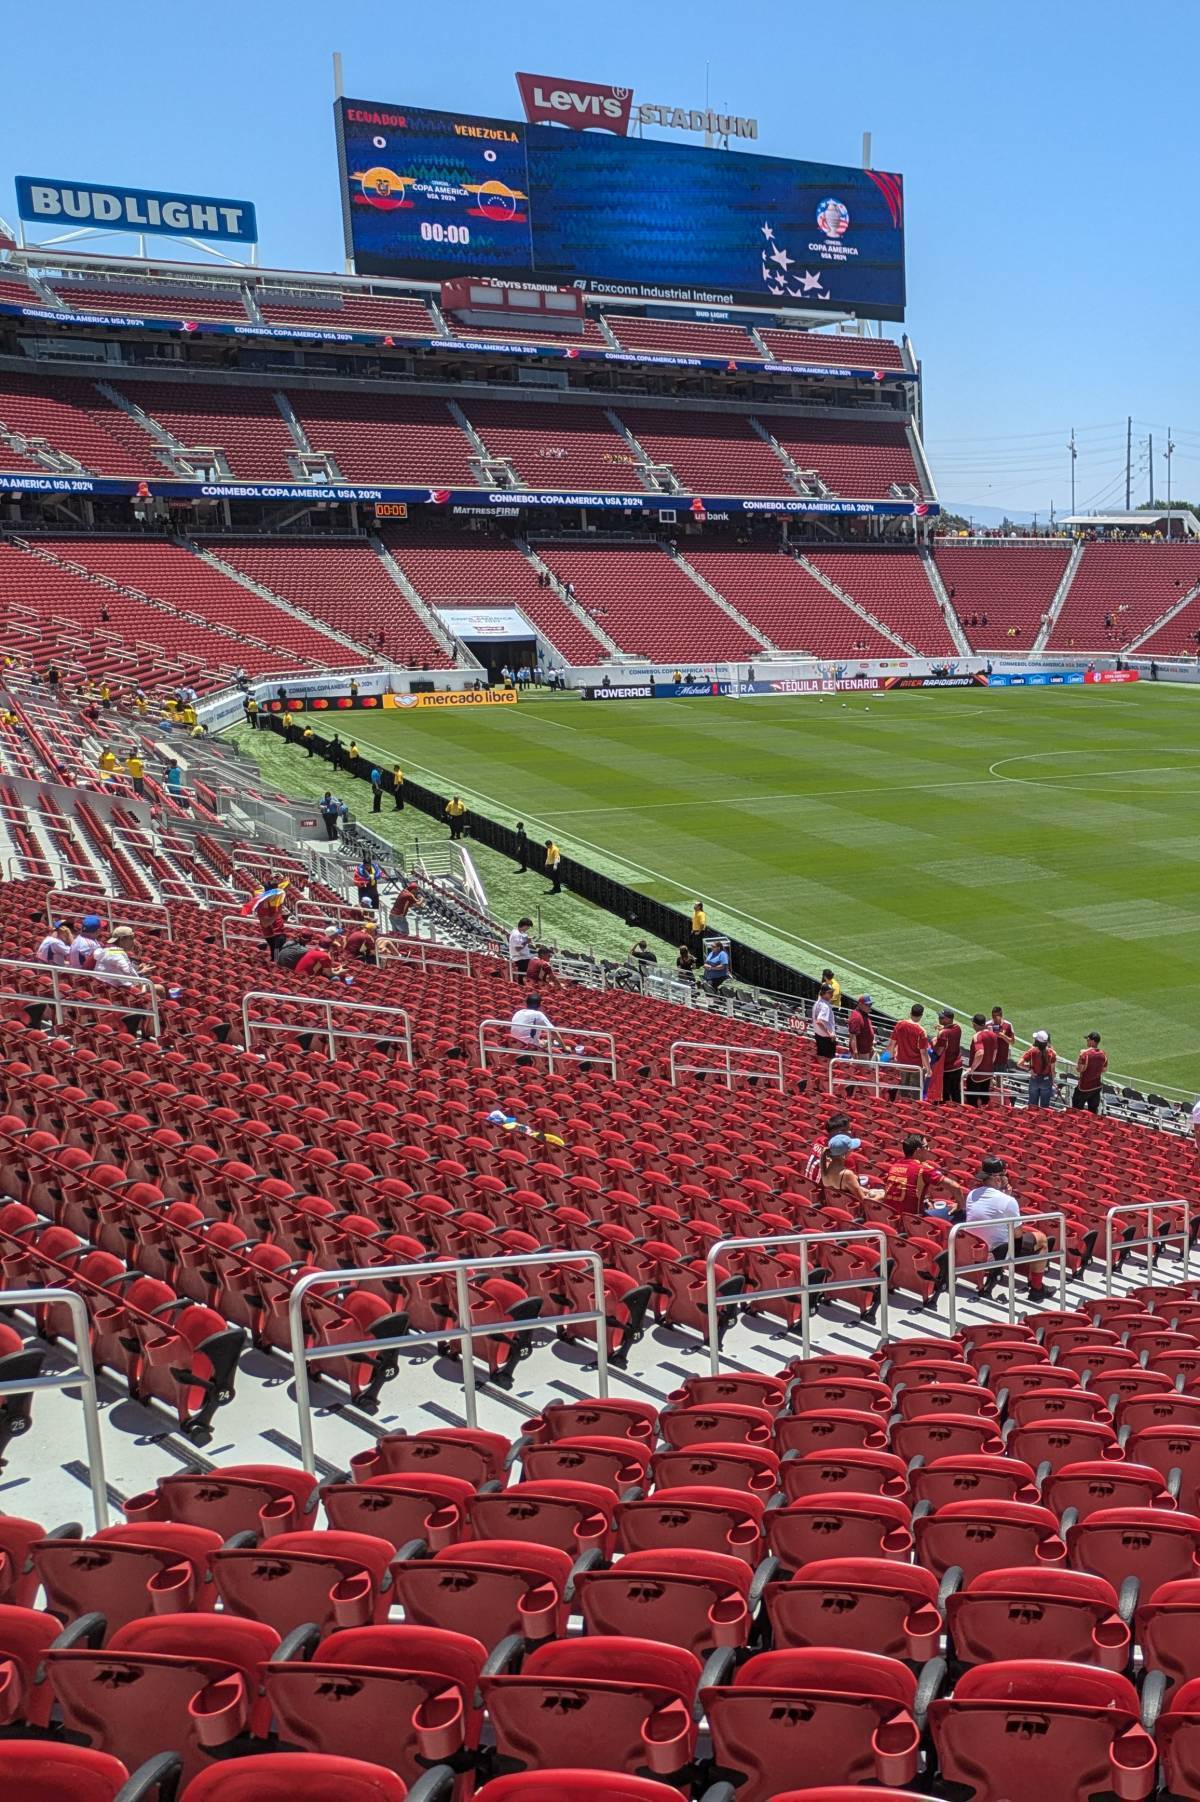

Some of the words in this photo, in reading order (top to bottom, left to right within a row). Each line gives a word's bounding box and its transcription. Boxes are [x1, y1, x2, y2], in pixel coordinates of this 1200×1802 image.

[347, 109, 408, 128] ECUADOR
[640, 103, 758, 140] STADIUM
[454, 124, 519, 144] VENEZUELA
[372, 136, 386, 148] 0
[484, 150, 496, 162] 0
[412, 184, 434, 192] COPA
[434, 186, 469, 196] AMERICA
[31, 186, 122, 220] BUD
[125, 197, 242, 234] LIGHT
[420, 222, 470, 244] 00:00
[808, 243, 827, 252] COPA
[828, 245, 858, 256] AMERICA
[522, 282, 558, 292] STADIUM
[590, 280, 638, 296] Foxconn
[640, 284, 692, 301] Industrial
[693, 286, 734, 305] Internet
[22, 308, 57, 320] CONMEBOL
[57, 313, 74, 322] COPA
[76, 315, 110, 325] AMERICA
[111, 317, 126, 326] USA
[126, 318, 144, 326] 2024
[696, 310, 709, 318] BUD
[235, 326, 273, 336] CONMEBOL
[274, 328, 292, 337] COPA
[292, 330, 322, 338] AMERICA
[322, 332, 336, 340] USA
[336, 332, 352, 340] 2024
[430, 340, 466, 349] CONMEBOL
[466, 342, 482, 350] COPA
[482, 343, 510, 352] AMERICA
[510, 344, 522, 353] USA
[10, 479, 52, 490] AMERICA
[53, 480, 70, 490] USA
[72, 481, 94, 490] 2024
[202, 486, 260, 497] CONMEBOL
[261, 488, 291, 498] COPA
[291, 489, 336, 499] AMERICA
[337, 490, 356, 499] USA
[357, 490, 382, 500] 2024
[489, 494, 540, 504] CONMEBOL
[540, 495, 564, 504] COPA
[564, 495, 604, 505] AMERICA
[604, 496, 622, 506] USA
[622, 497, 643, 506] 2024
[376, 504, 406, 516] 00:00
[742, 501, 786, 510] CONMEBOL
[786, 502, 808, 510] COPA
[807, 502, 840, 512] AMERICA
[841, 504, 856, 512] USA
[856, 504, 874, 512] 2024
[707, 510, 730, 520] bank
[780, 680, 818, 693] TEQUILA
[822, 679, 878, 690] CENTENARIO
[423, 692, 484, 706] mercado
[486, 691, 514, 703] libre
[594, 688, 652, 698] POWERADE
[790, 1018, 805, 1030] 109
[520, 1348, 528, 1356] 22
[385, 1368, 394, 1376] 23
[218, 1390, 230, 1400] 24
[11, 1419, 24, 1430] 25
